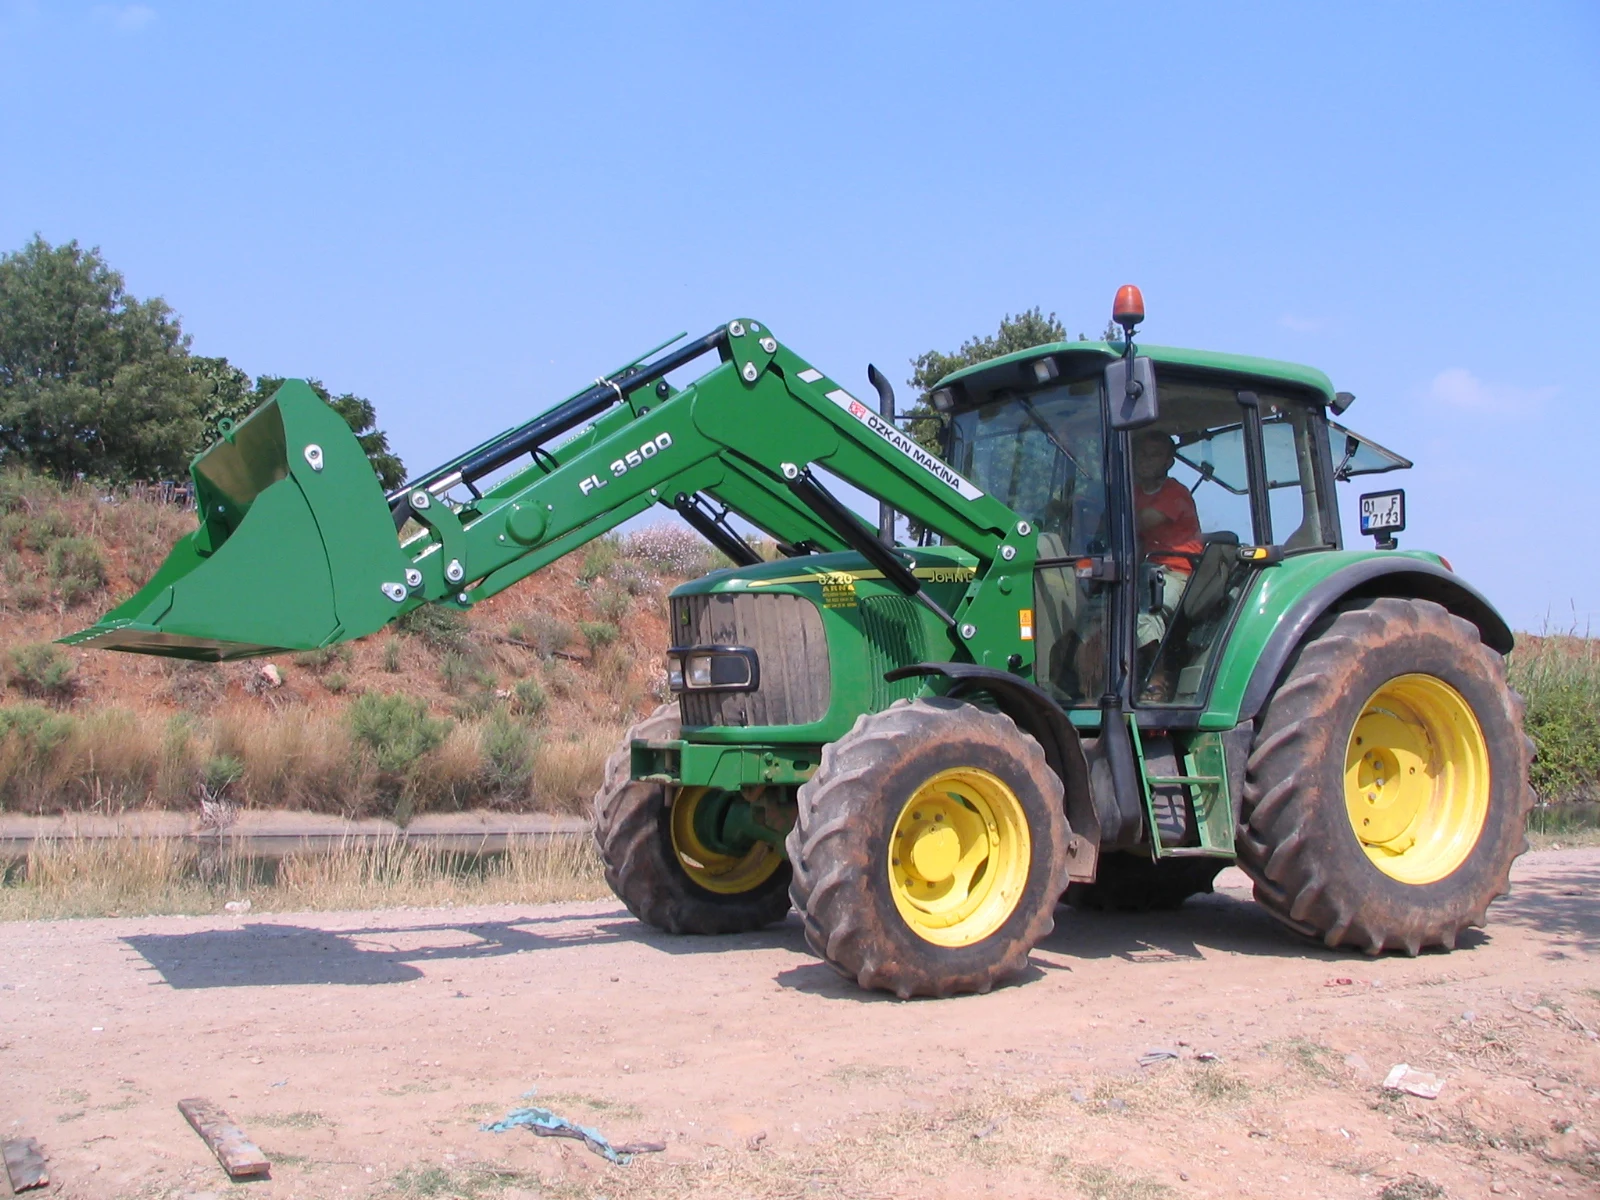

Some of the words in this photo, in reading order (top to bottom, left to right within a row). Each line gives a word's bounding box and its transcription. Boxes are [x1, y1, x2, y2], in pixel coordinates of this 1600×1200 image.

[867, 416, 912, 453] ÖZKAN
[912, 449, 960, 490] MAKİNA
[579, 474, 608, 496] FL
[610, 432, 673, 478] 3500
[1363, 500, 1375, 513] 01
[1372, 511, 1399, 526] 7123
[928, 570, 964, 583] JOHN
